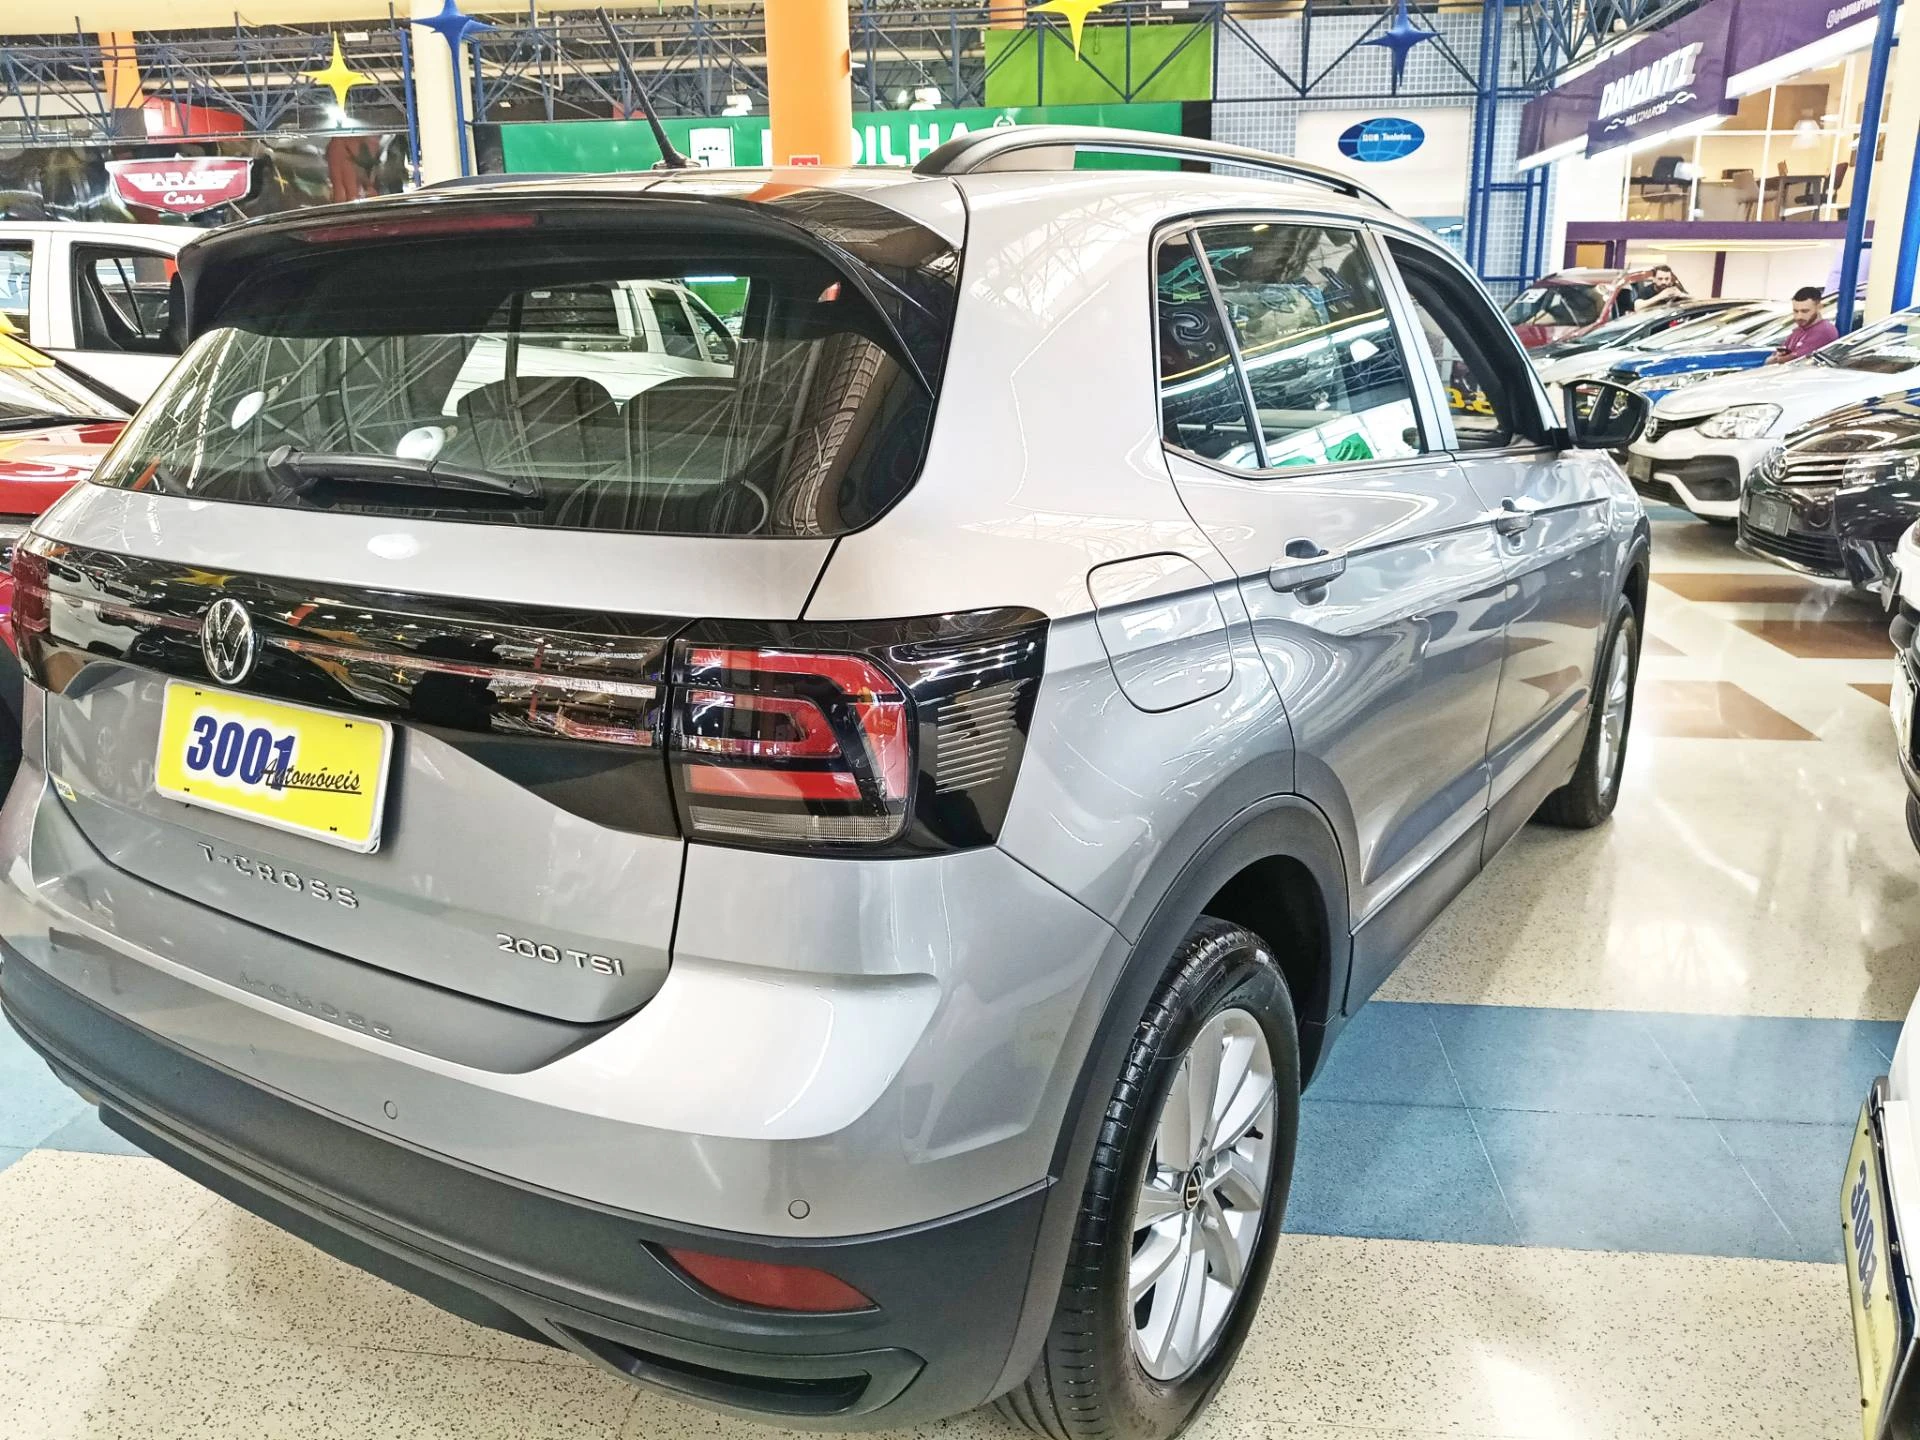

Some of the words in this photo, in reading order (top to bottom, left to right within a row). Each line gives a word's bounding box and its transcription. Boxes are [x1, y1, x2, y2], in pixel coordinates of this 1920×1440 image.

[1598, 42, 1703, 120] DAVANTI
[163, 191, 205, 205] Cars
[186, 715, 296, 791] 3001
[261, 758, 362, 793] Automóveis
[198, 841, 360, 909] T-CROSS
[496, 932, 561, 964] 200
[566, 948, 624, 977] TSI
